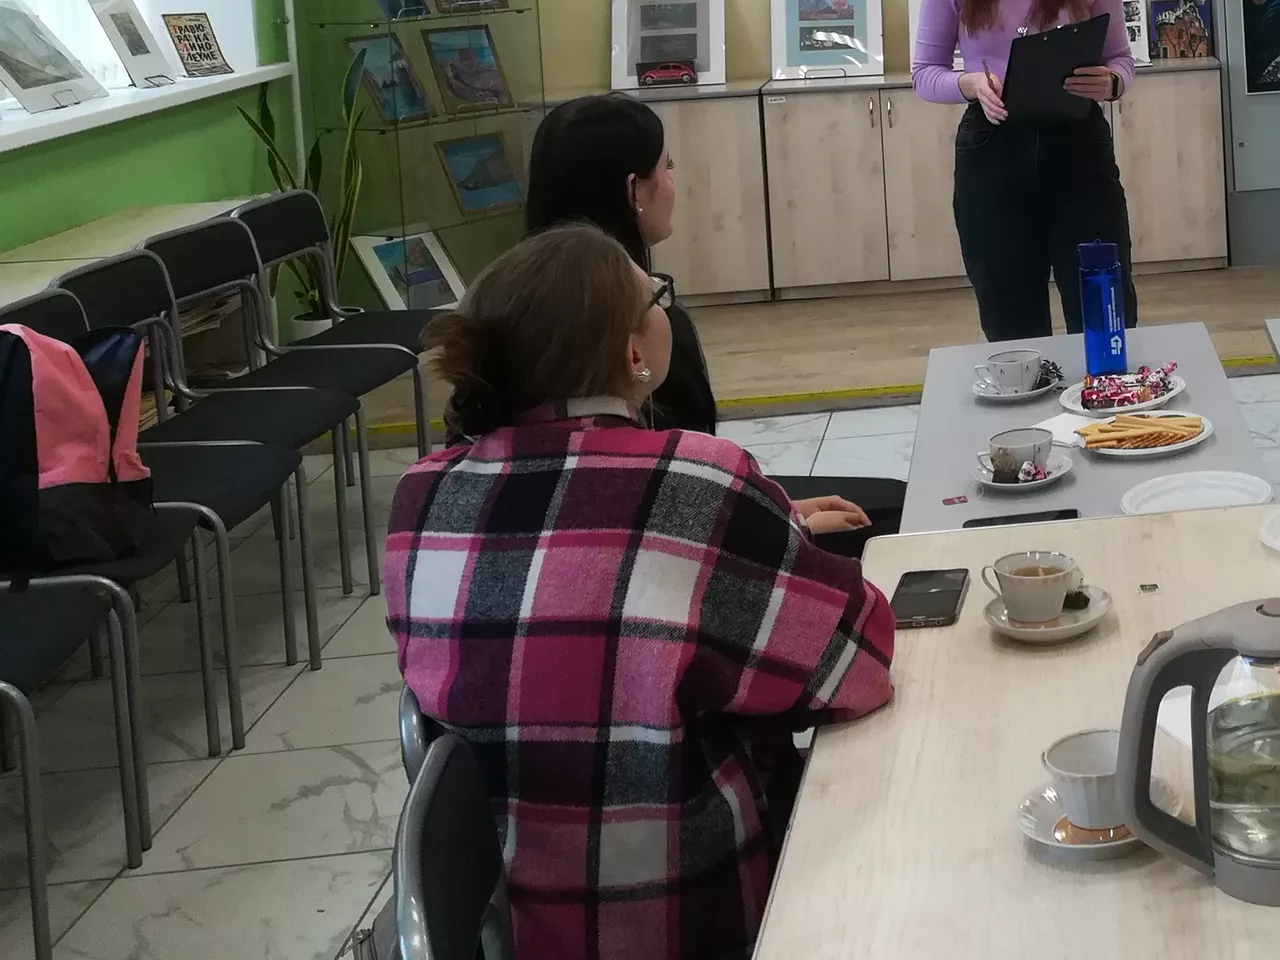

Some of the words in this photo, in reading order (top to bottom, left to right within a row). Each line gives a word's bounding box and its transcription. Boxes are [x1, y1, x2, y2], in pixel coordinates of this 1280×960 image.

[194, 33, 210, 43] НА
[182, 41, 214, 52] ЛИНО-
[185, 51, 218, 62] ЛЕУМЕ
